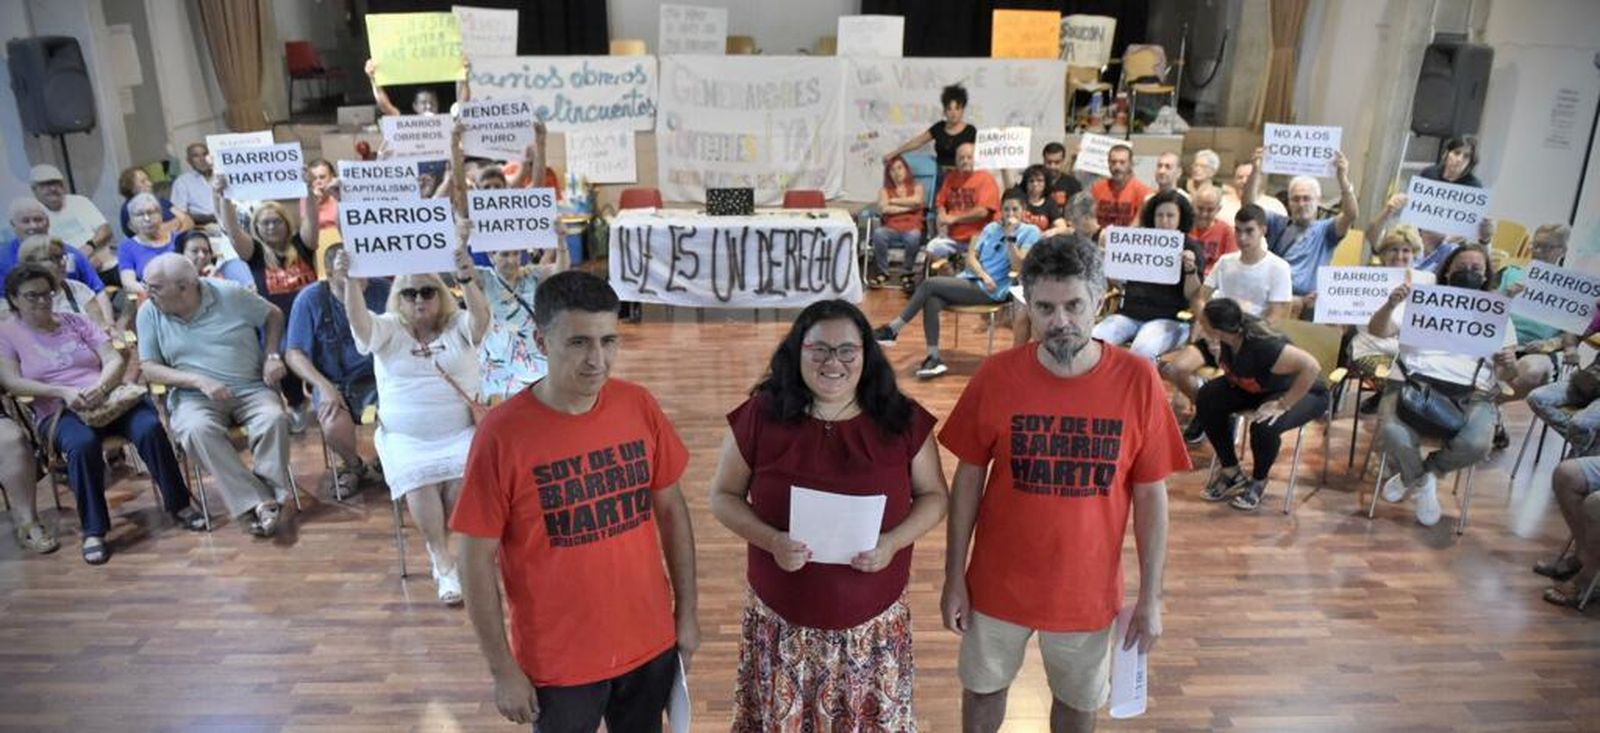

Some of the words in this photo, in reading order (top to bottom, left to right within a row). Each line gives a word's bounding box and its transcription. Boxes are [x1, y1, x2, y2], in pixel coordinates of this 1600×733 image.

[463, 101, 529, 118] #ENDESA
[396, 119, 442, 130] BARRIOS
[392, 131, 444, 142] OBREROS
[481, 132, 517, 144] PURO
[1274, 129, 1291, 139] NO
[1293, 129, 1303, 140] A
[1305, 130, 1330, 142] LOS
[221, 149, 299, 166] BARRIOS
[978, 144, 1025, 157] HARTOS
[1268, 143, 1333, 160] CORTES
[228, 169, 299, 185] HARTOS
[342, 164, 416, 180] #ENDESA
[343, 183, 418, 194] CAPITALISMO
[1412, 181, 1488, 207] BARRIOS
[472, 194, 552, 211] BARRIOS
[345, 206, 447, 226] BARRIOS
[1409, 200, 1479, 225] HARTOS
[477, 216, 550, 234] HARTOS
[353, 231, 447, 254] HARTOS
[1109, 231, 1180, 249] BARRIOS
[665, 225, 700, 293] ES
[712, 225, 749, 303] UN
[753, 226, 855, 298] DERECHO
[1111, 251, 1175, 268] HARTOS
[1333, 271, 1389, 283] BARRIOS
[1528, 266, 1600, 298] BARRIOS
[1327, 286, 1389, 298] OBREROS
[1412, 289, 1506, 314] BARRIOS
[1522, 286, 1590, 318] HARTOS
[1411, 313, 1497, 339] HARTOS
[1011, 414, 1054, 432] SOY
[1060, 416, 1089, 434] DE
[1092, 418, 1123, 437] UN
[1011, 432, 1121, 461] BARRIO
[533, 455, 582, 485] SOY
[588, 447, 617, 471] DE
[618, 439, 647, 461] UN
[1011, 457, 1117, 487] HARTO
[538, 460, 650, 510] BARRIO
[543, 487, 653, 537] HARTO
